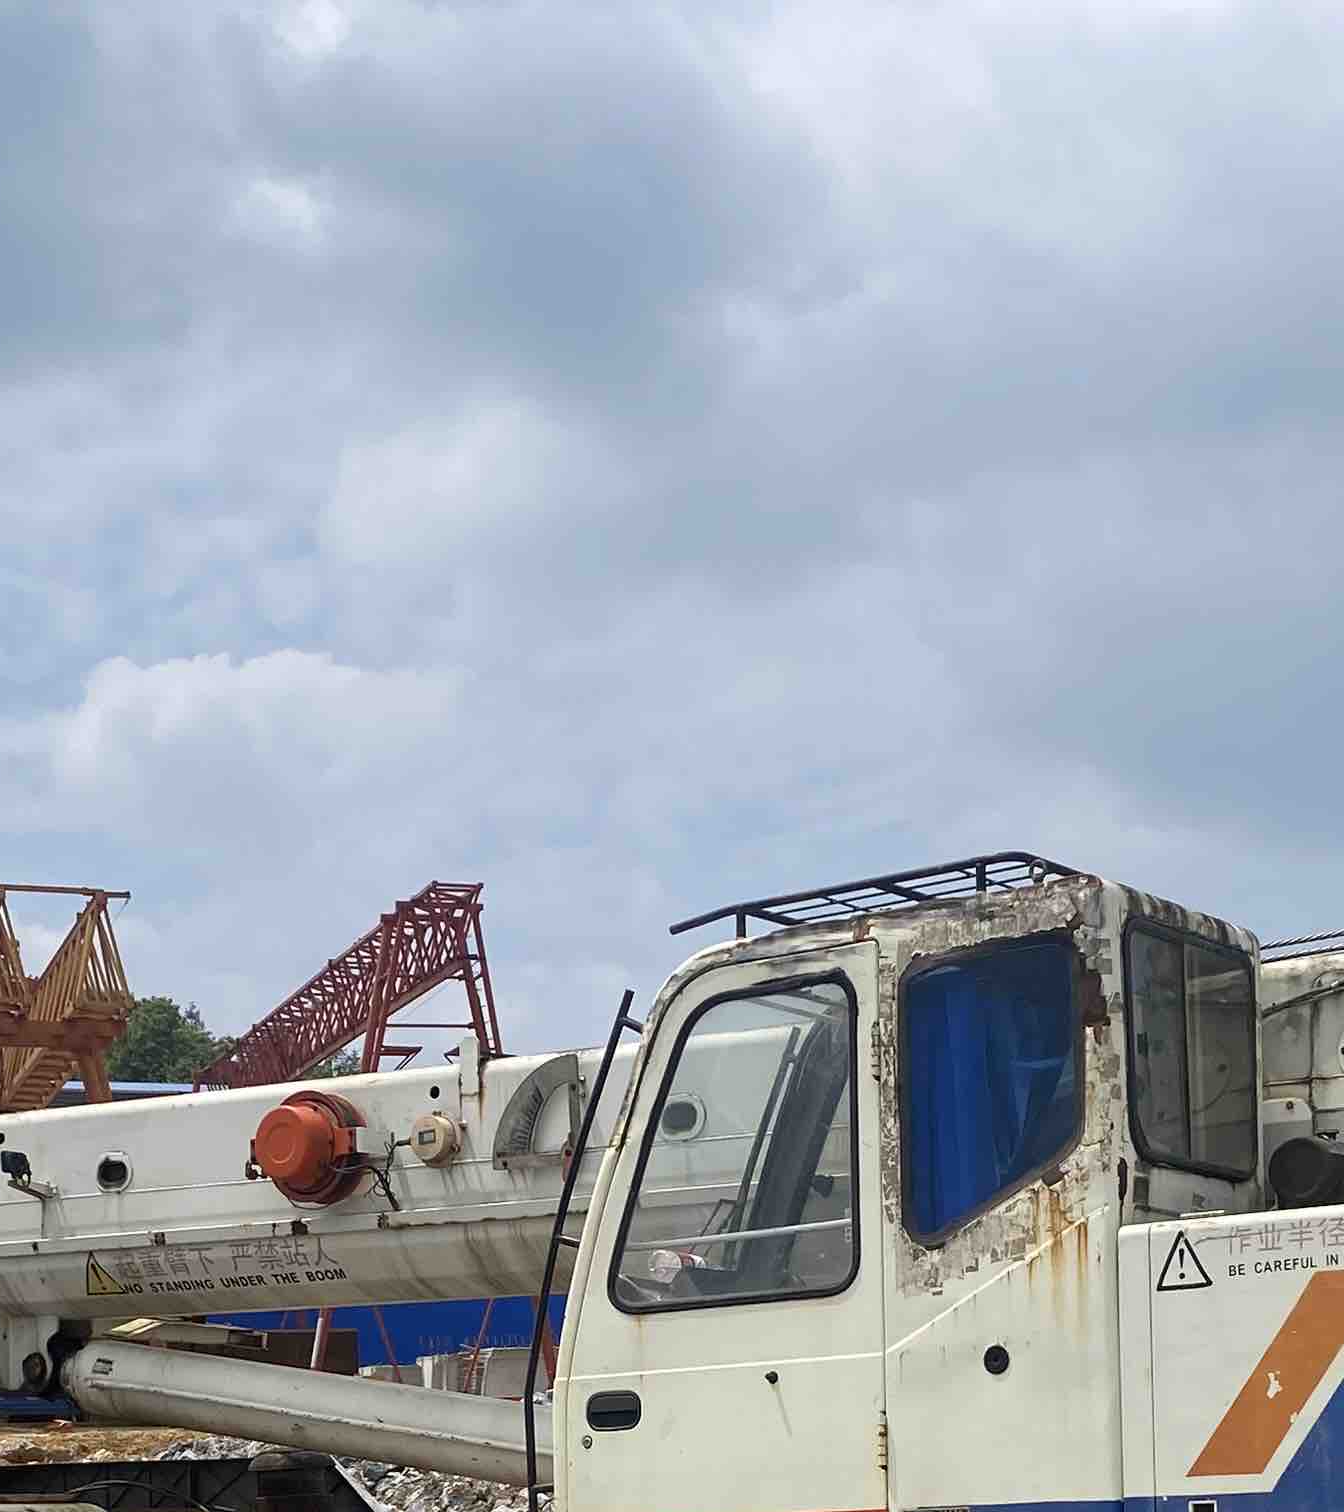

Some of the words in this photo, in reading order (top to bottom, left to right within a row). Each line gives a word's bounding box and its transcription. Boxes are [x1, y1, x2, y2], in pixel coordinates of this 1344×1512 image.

[1228, 1263, 1246, 1277] BE
[1253, 1255, 1318, 1274] CAREFUL
[1326, 1253, 1339, 1266] IN
[122, 1283, 144, 1295] NO
[149, 1279, 215, 1293] STANDING
[219, 1273, 267, 1289] UNDER
[271, 1271, 301, 1285] THE
[305, 1268, 348, 1282] BOOM
